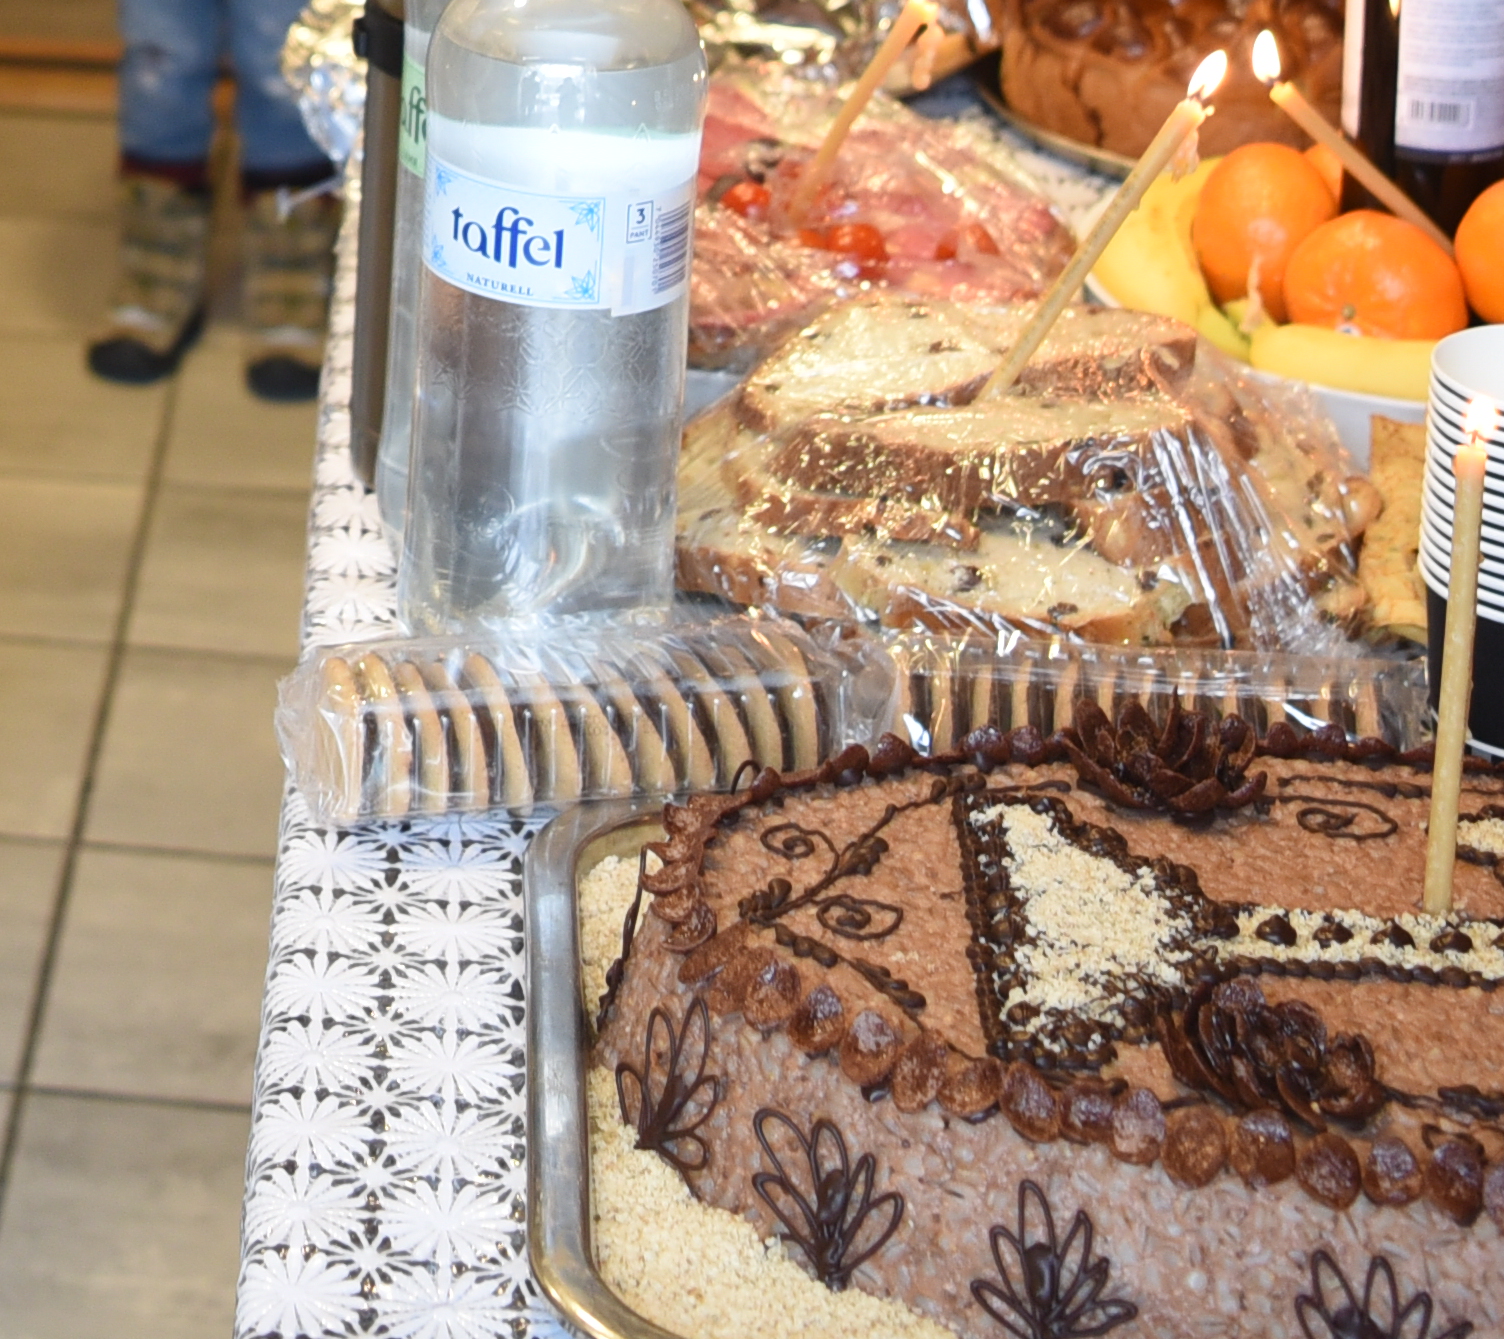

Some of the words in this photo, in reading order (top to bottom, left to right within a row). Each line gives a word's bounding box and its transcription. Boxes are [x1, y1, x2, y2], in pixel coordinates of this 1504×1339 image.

[401, 85, 427, 145] aff
[635, 207, 646, 225] 3
[451, 206, 565, 269] taffel
[629, 228, 649, 239] PANT
[466, 272, 535, 297] NATURELL
